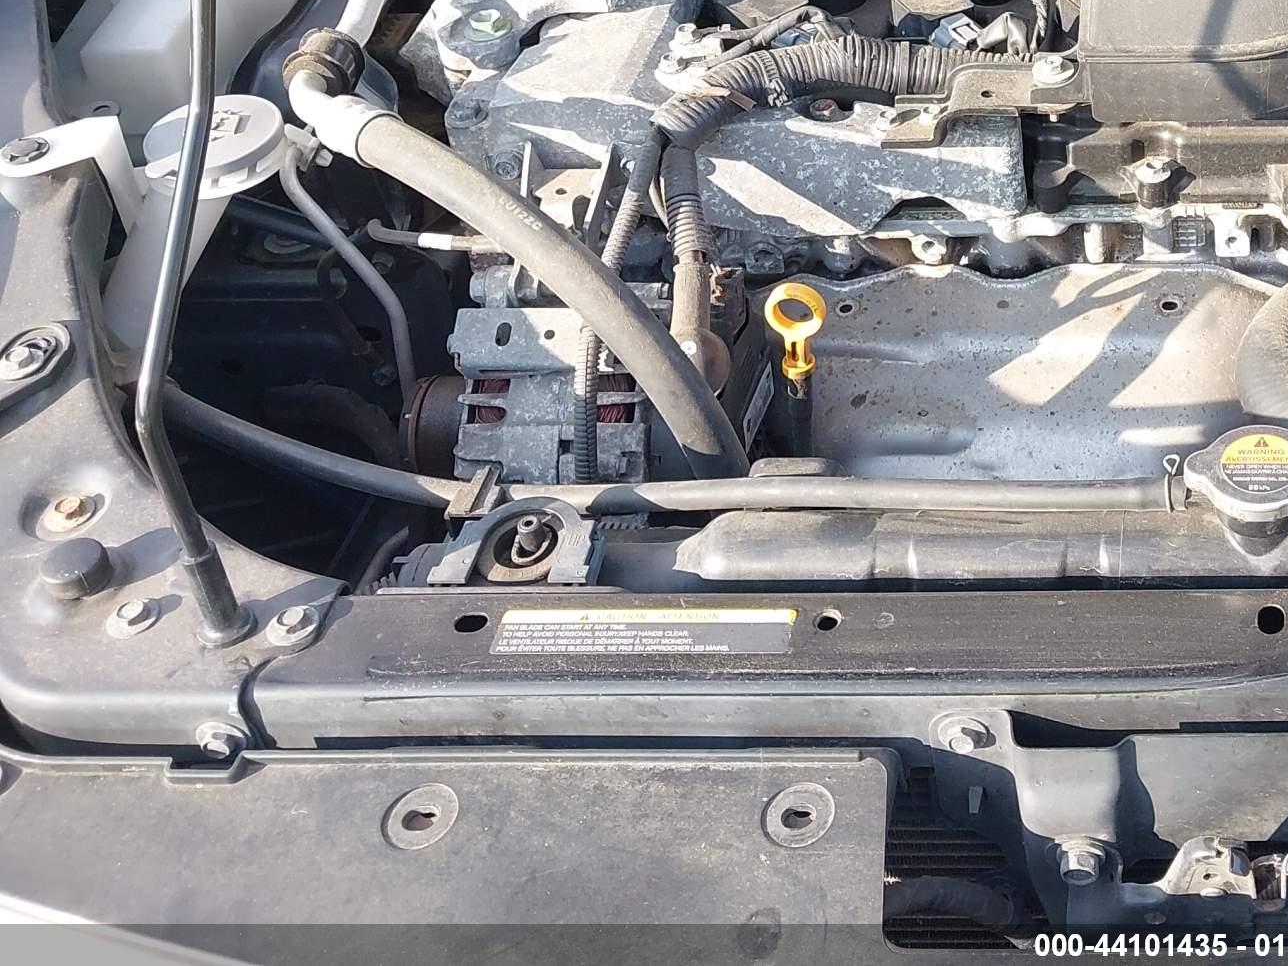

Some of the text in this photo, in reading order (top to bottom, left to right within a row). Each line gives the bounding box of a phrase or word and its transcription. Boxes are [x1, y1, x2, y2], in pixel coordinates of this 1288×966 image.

[598, 613, 721, 621] CAUTION ATTENTION
[512, 630, 532, 638] HELP
[532, 630, 555, 638] AVOID
[555, 630, 593, 638] PERSONAL
[638, 630, 664, 638] HANDS
